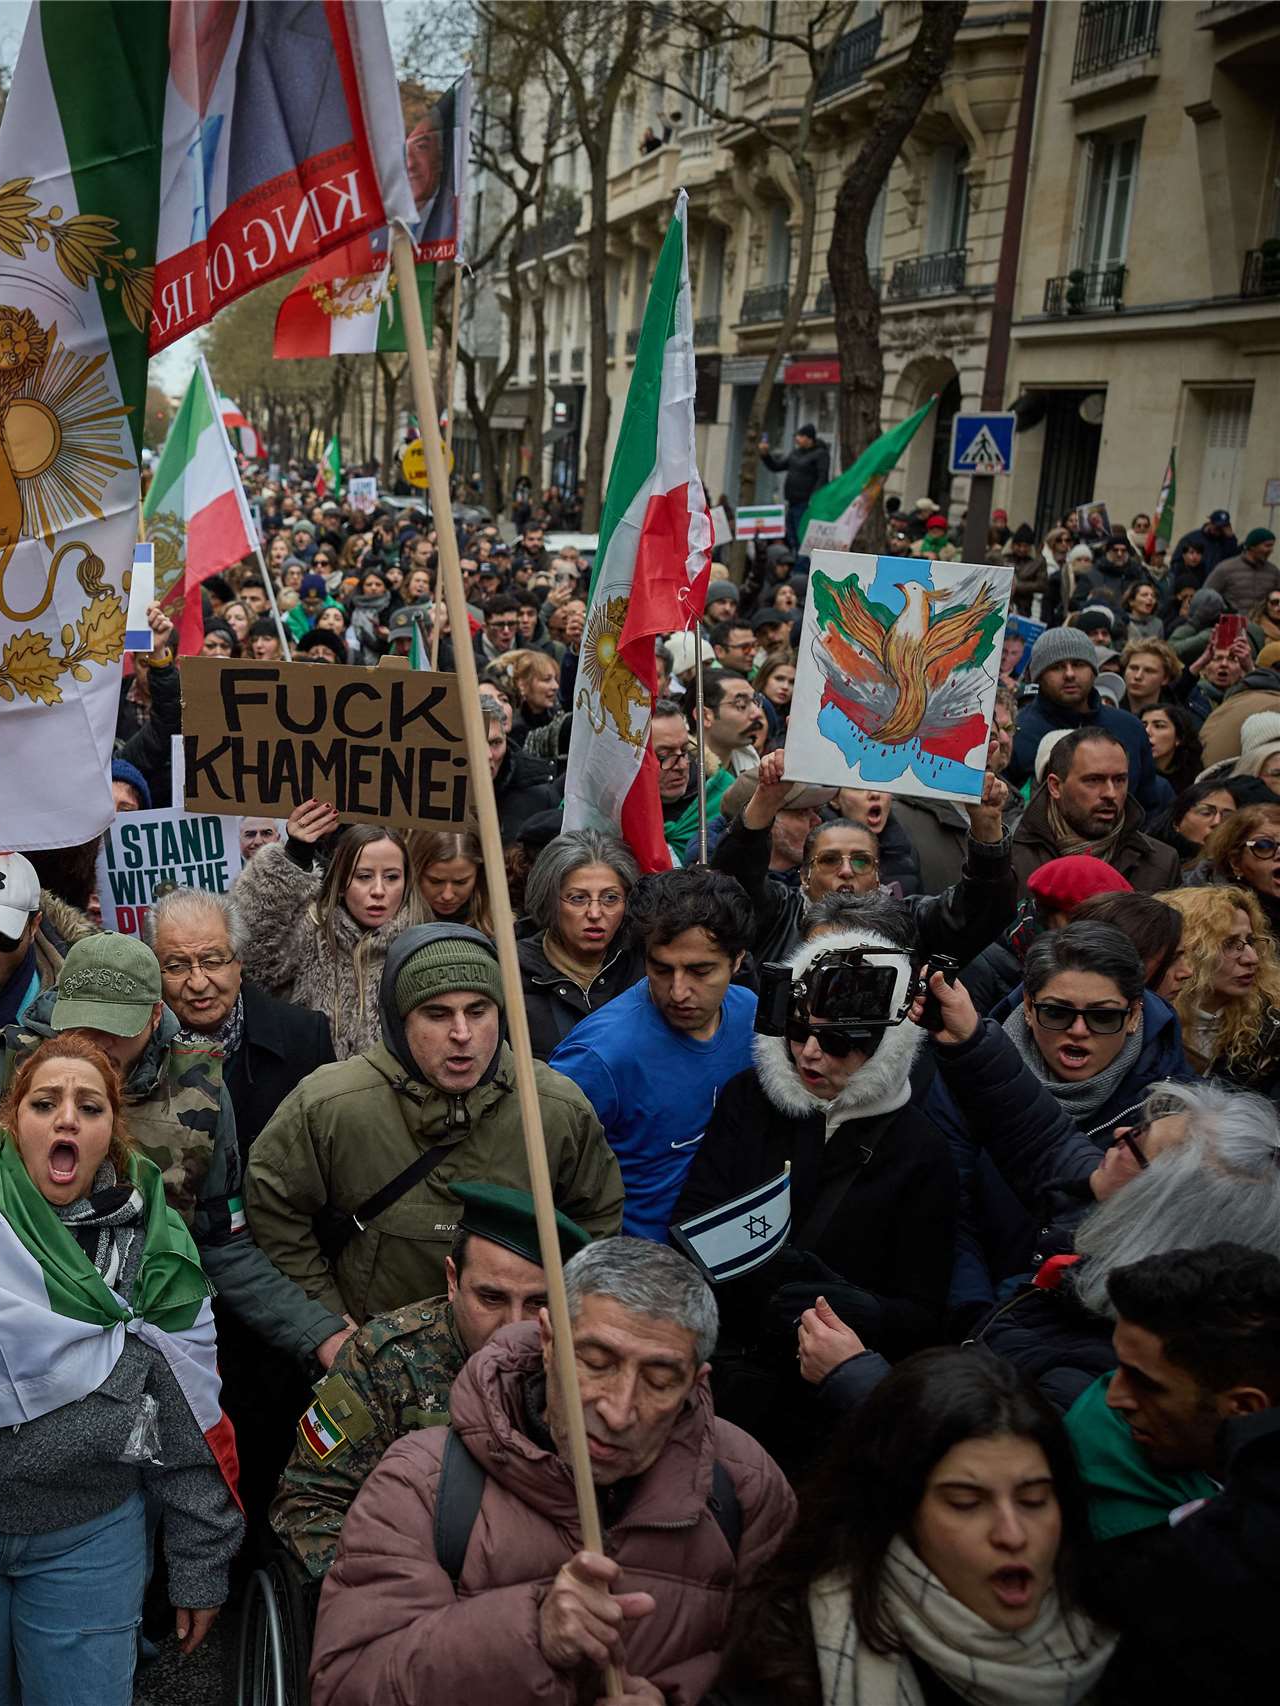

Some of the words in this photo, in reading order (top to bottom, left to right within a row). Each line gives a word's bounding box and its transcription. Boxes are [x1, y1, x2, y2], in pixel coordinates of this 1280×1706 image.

[220, 668, 463, 742] FUCK
[103, 826, 116, 870] I
[120, 816, 225, 869] STAND
[182, 861, 229, 894] THE
